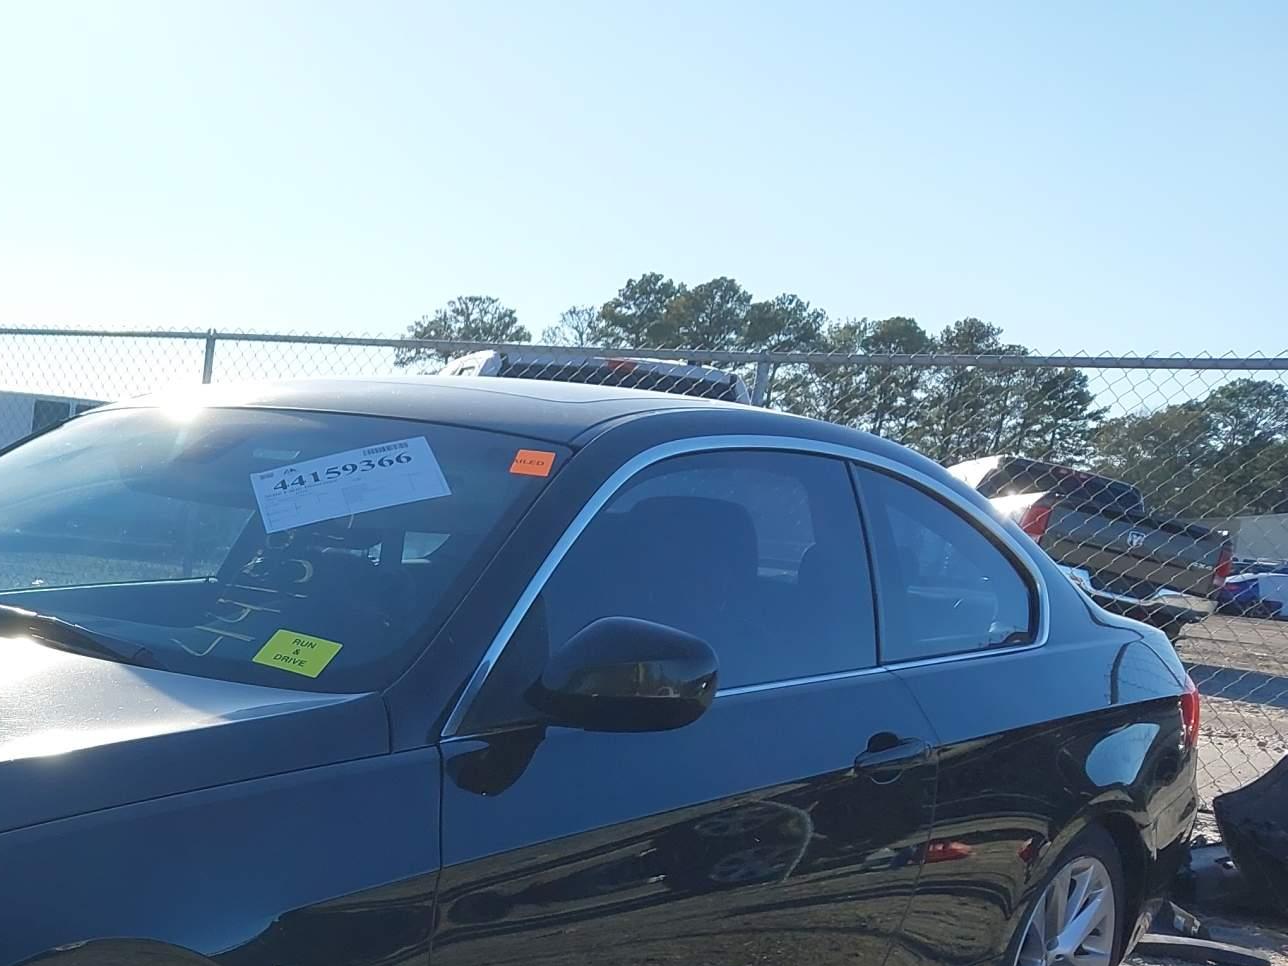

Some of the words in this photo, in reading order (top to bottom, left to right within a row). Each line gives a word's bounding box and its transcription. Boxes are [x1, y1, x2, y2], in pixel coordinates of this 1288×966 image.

[273, 452, 412, 491] 44159366
[292, 638, 318, 649] RUN
[292, 648, 301, 656] &
[273, 653, 309, 667] DRIVE
